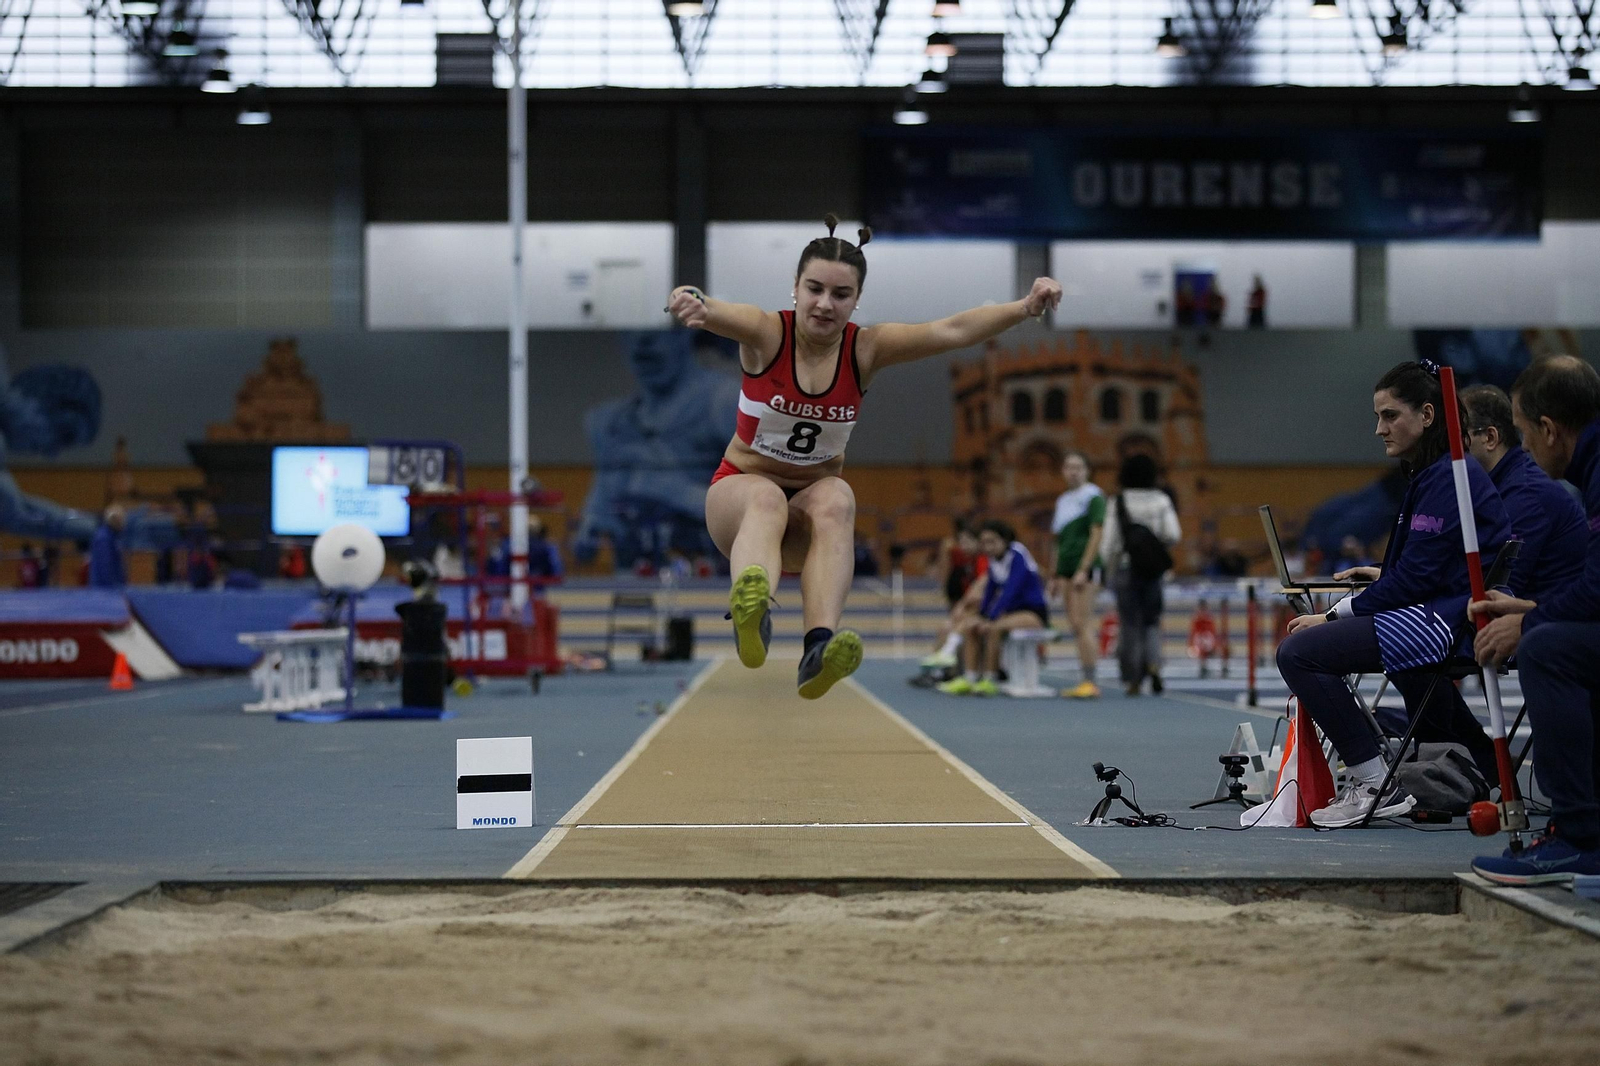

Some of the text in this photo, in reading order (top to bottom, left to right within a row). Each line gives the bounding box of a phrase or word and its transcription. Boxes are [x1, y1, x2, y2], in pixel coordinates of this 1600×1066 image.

[1073, 162, 1341, 207] OURENSE
[827, 405, 856, 421] S16
[786, 421, 822, 454] 8
[472, 817, 517, 827] MONDO
